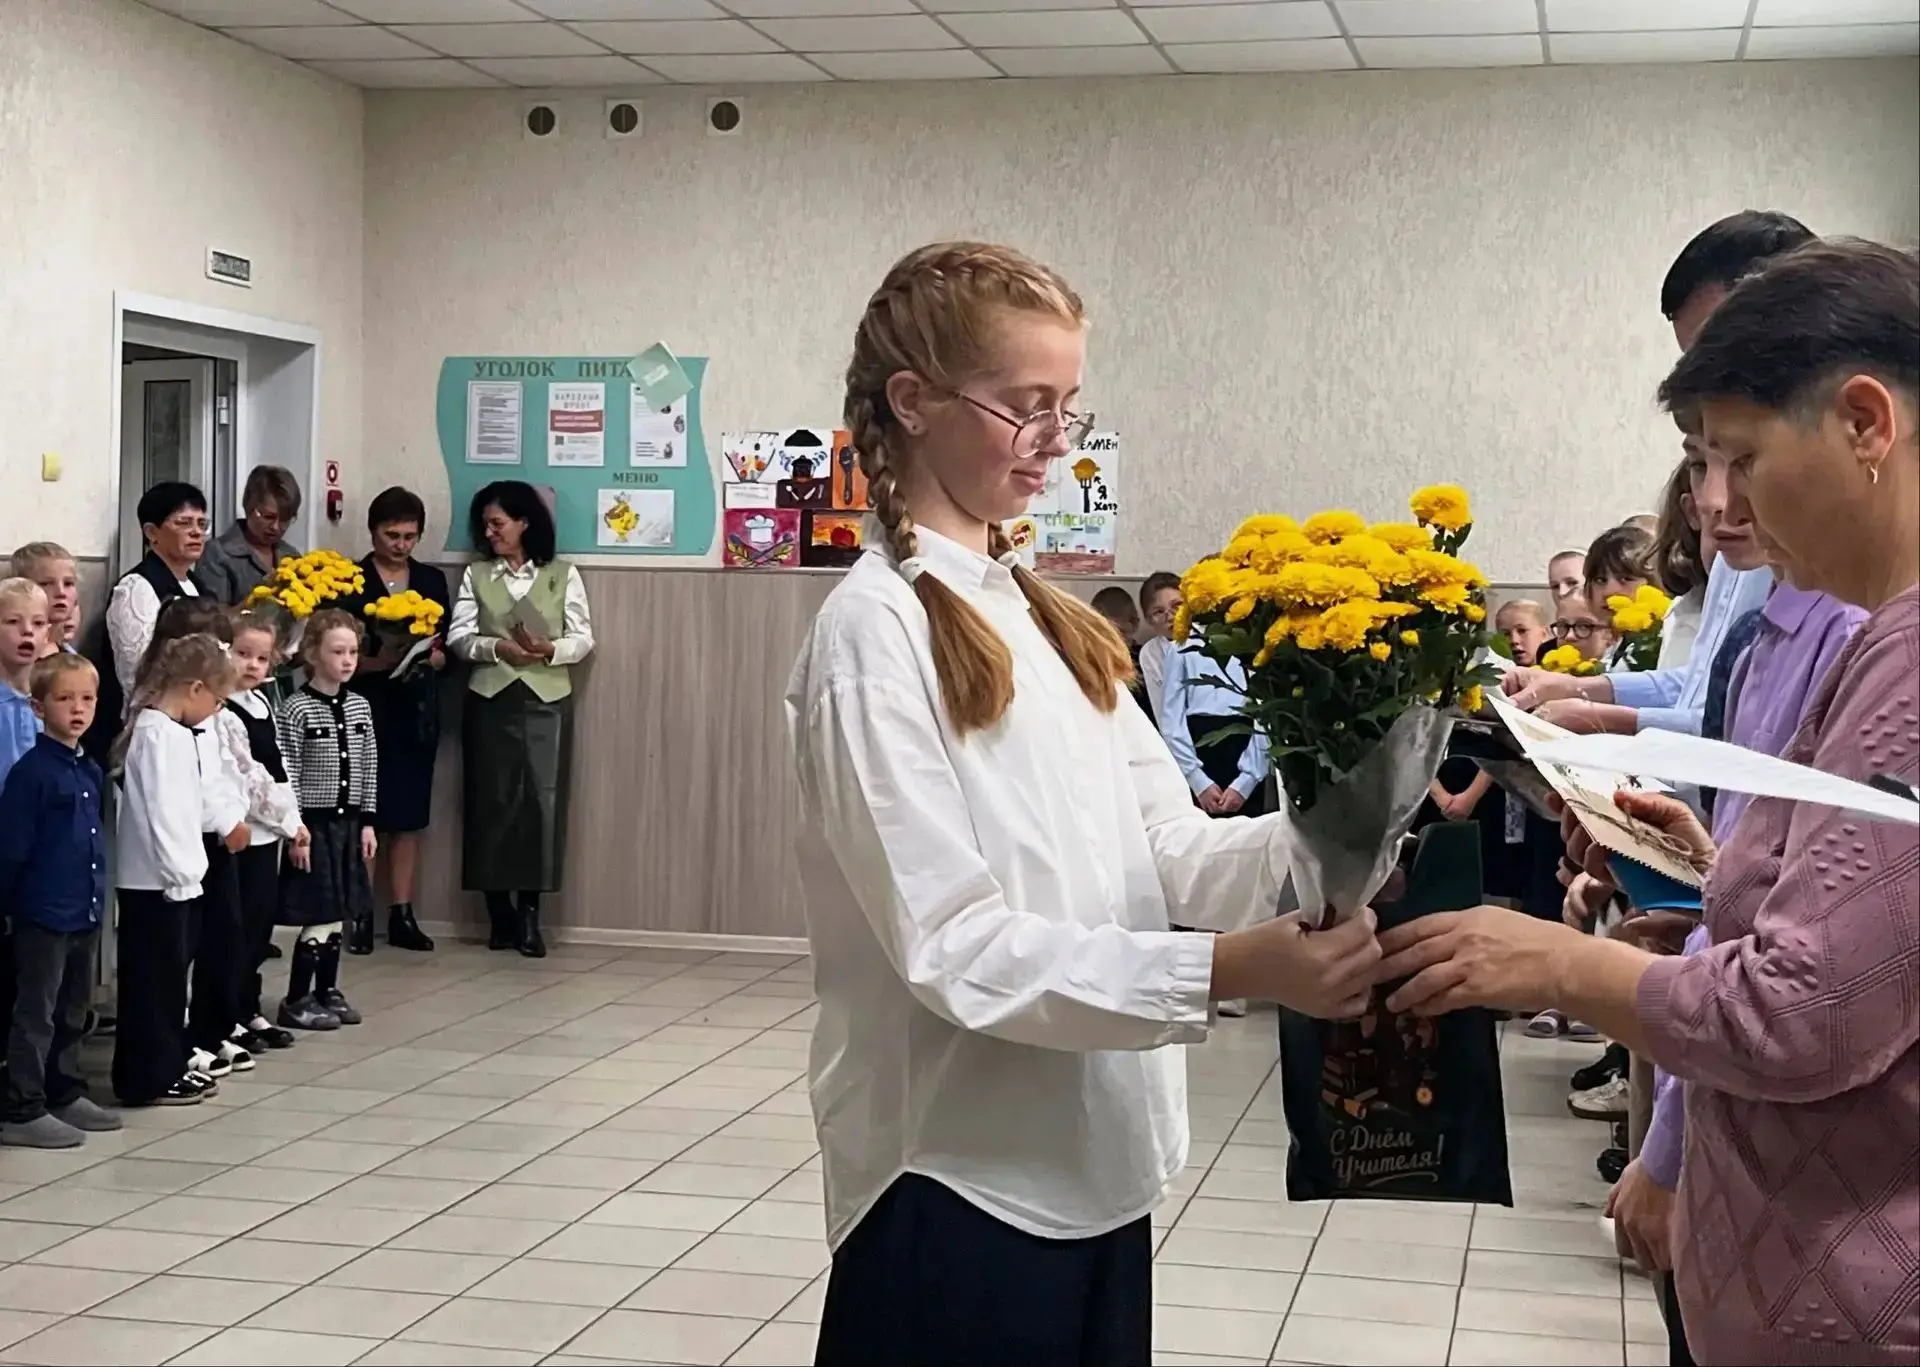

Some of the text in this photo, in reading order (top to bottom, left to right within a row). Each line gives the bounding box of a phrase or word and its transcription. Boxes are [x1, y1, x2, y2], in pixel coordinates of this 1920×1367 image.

[475, 361, 632, 377] УГОЛОК ПИТА
[612, 472, 659, 484] МЕНЮ
[1097, 485, 1107, 500] Я
[1330, 1125, 1414, 1156] С Днём
[1332, 1134, 1444, 1187] Учителя!
